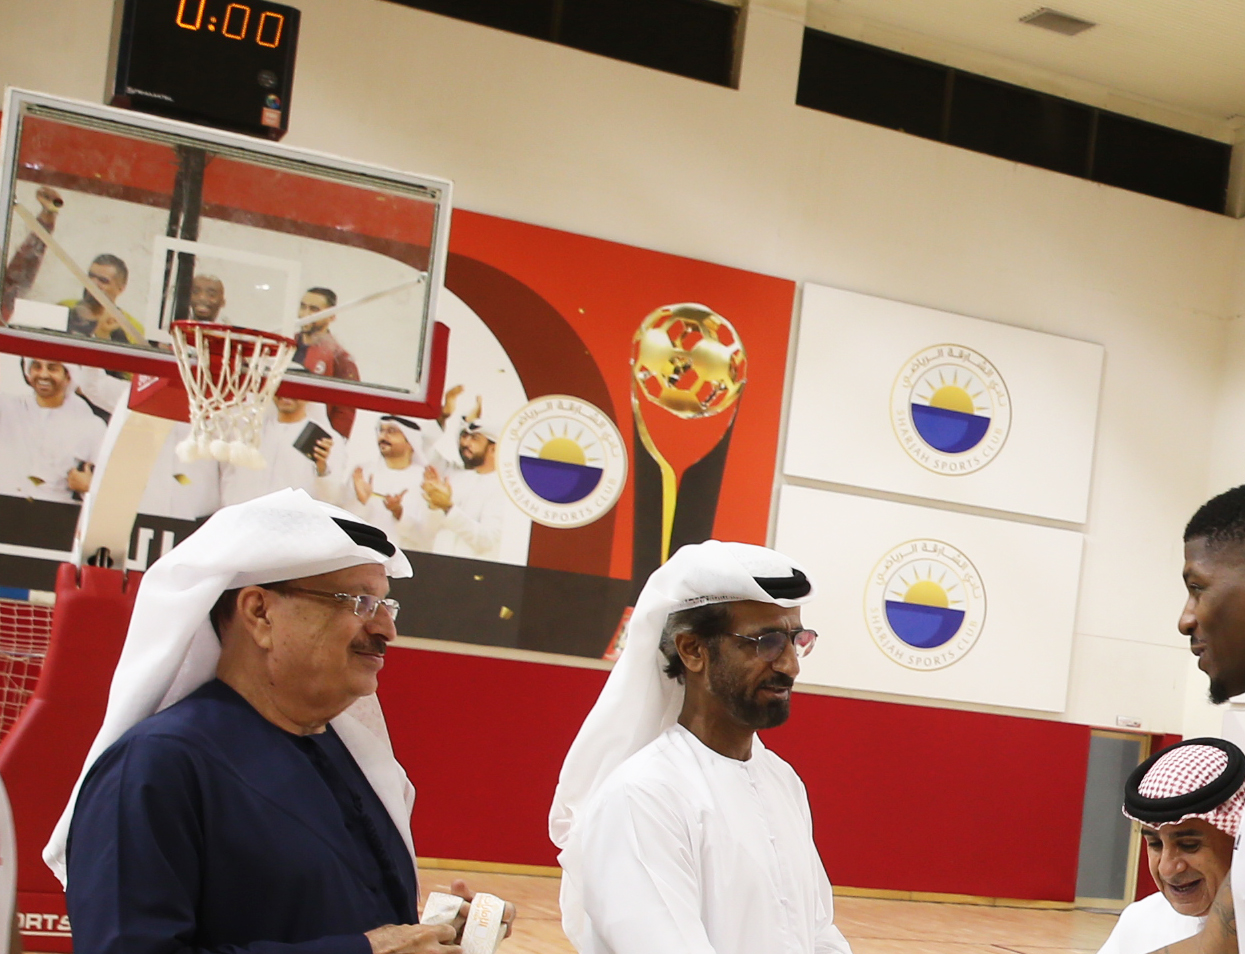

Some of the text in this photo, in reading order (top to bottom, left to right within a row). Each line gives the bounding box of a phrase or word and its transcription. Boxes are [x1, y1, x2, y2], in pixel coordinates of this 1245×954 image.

[175, 0, 285, 48] 0:00
[896, 409, 1004, 472] SHARJAH SPORTS CLUB
[503, 461, 618, 523] SHARJAH SPORTS CLUB
[870, 607, 979, 667] SHARJAH SPORTS CLUB
